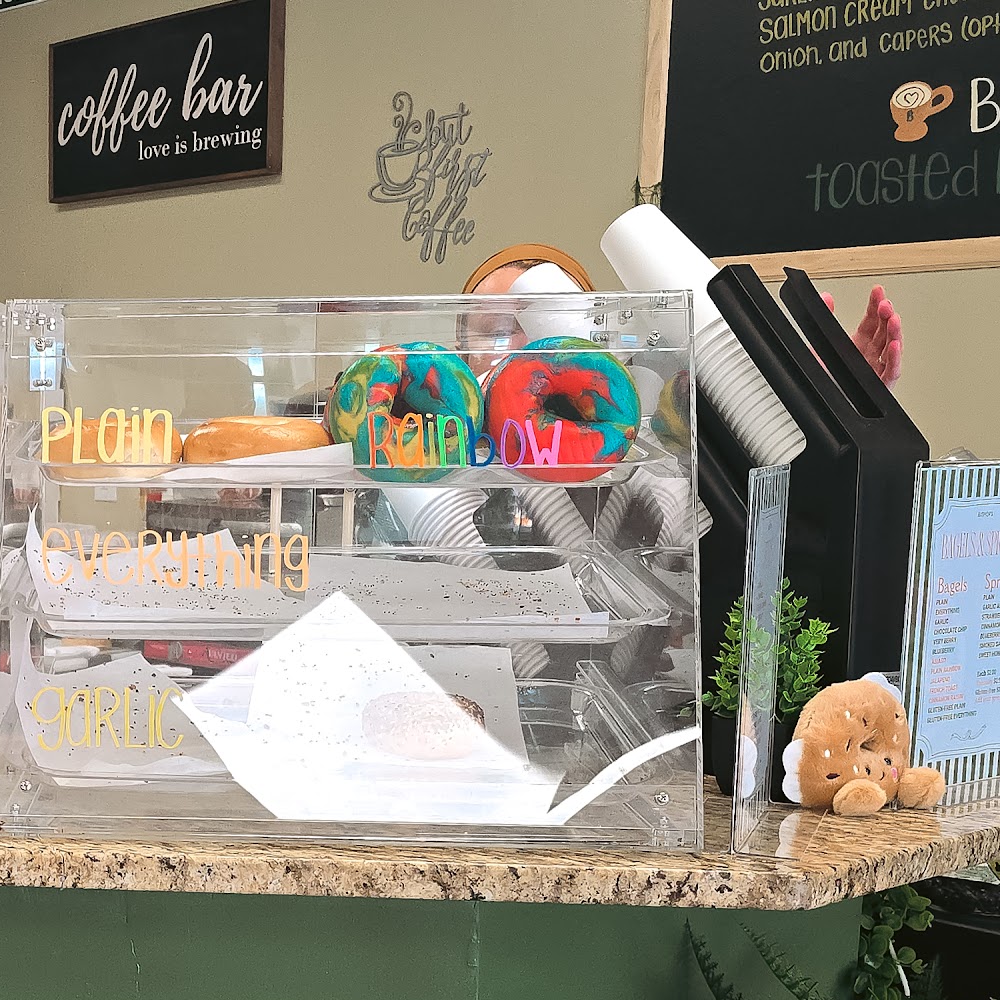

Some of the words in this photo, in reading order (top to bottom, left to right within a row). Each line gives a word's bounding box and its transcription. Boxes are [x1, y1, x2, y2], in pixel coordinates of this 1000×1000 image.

[828, 36, 867, 63] and
[58, 63, 172, 156] coffee
[181, 32, 264, 122] bar
[138, 140, 170, 161] love
[175, 134, 188, 155] is
[192, 124, 263, 152] brewing
[420, 102, 473, 147] but
[805, 150, 979, 213] toasted
[937, 576, 968, 596] Bagels
